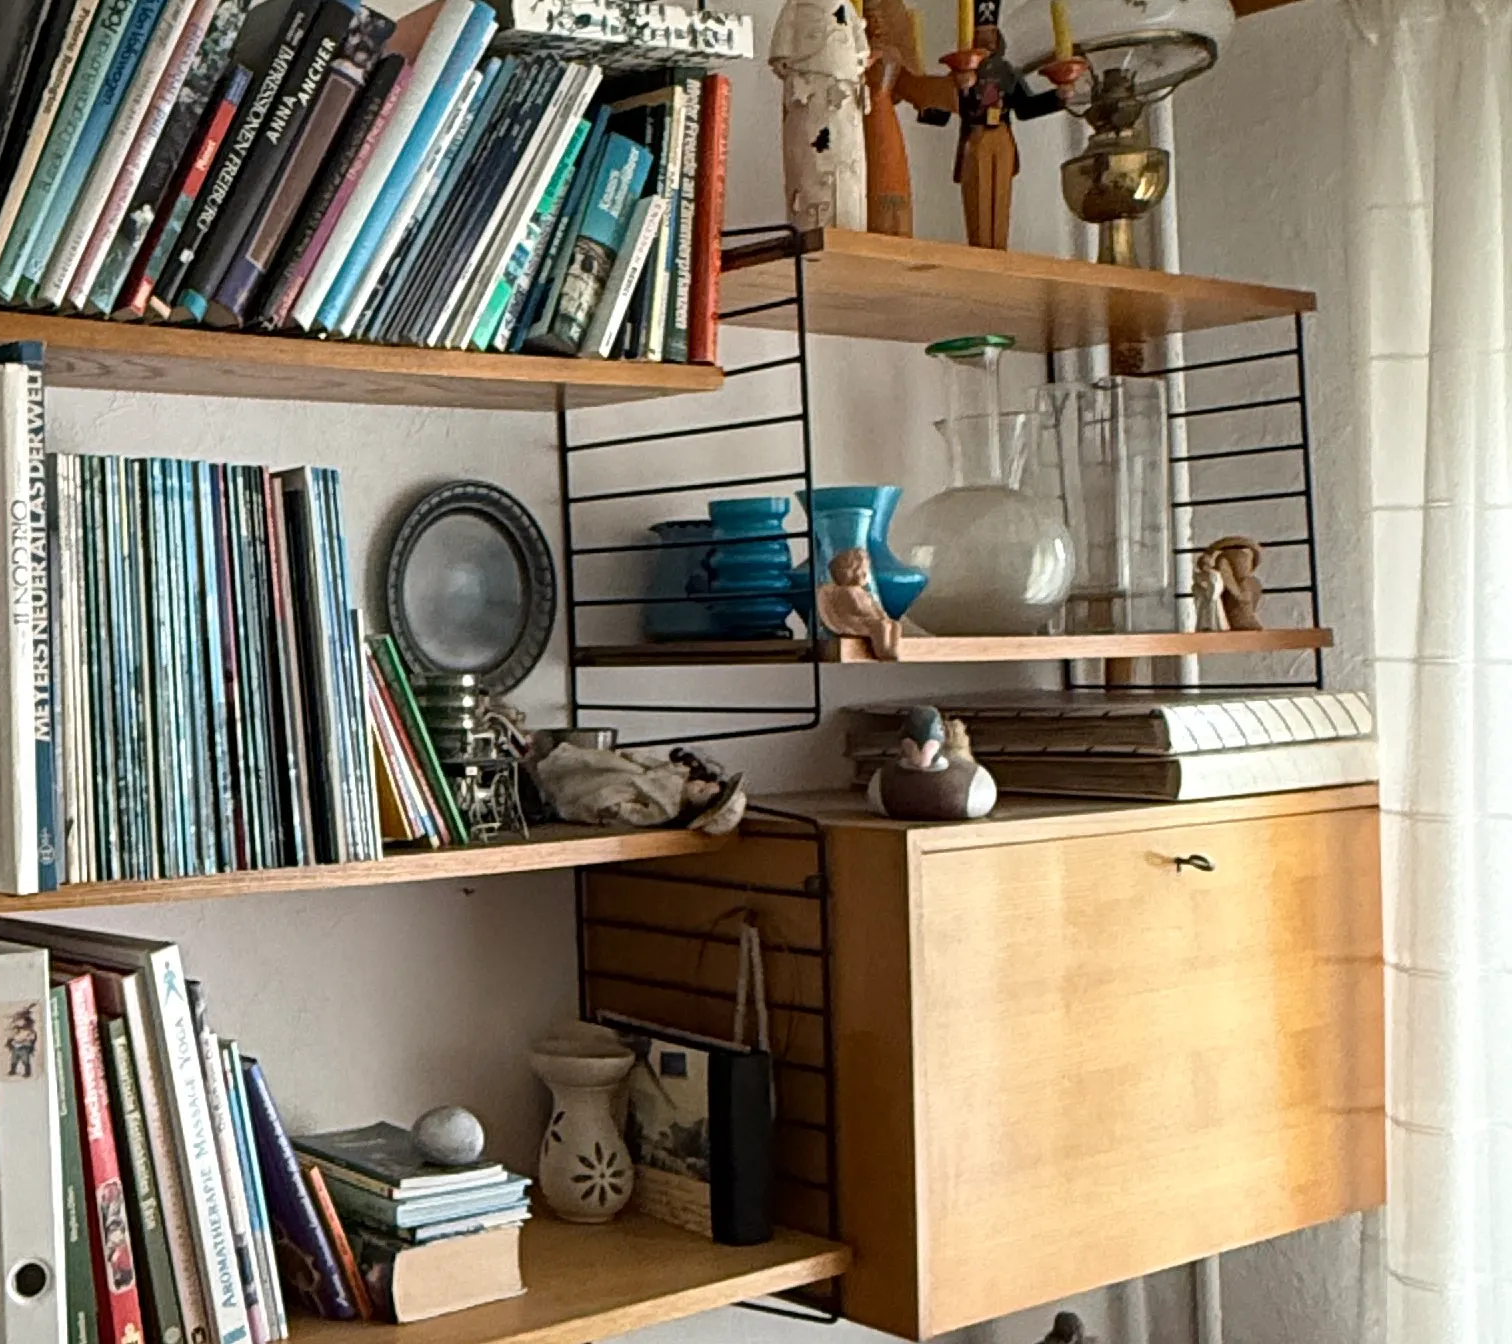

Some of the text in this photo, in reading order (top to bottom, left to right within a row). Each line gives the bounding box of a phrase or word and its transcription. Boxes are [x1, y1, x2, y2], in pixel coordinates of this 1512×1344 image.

[98, 27, 145, 108] Volkswagen
[290, 35, 340, 107] ANCHER
[194, 43, 295, 234] IMPRESSIONEN FREIBURG
[262, 92, 303, 147] ANNA
[27, 431, 43, 478] DER
[29, 480, 46, 554] ATLAS
[5, 498, 35, 626] OREGON II
[31, 559, 49, 640] NEUER
[33, 644, 51, 741] MEYERS
[170, 1016, 237, 1309] AROMATHERAPIE MASSAGE YOGA
